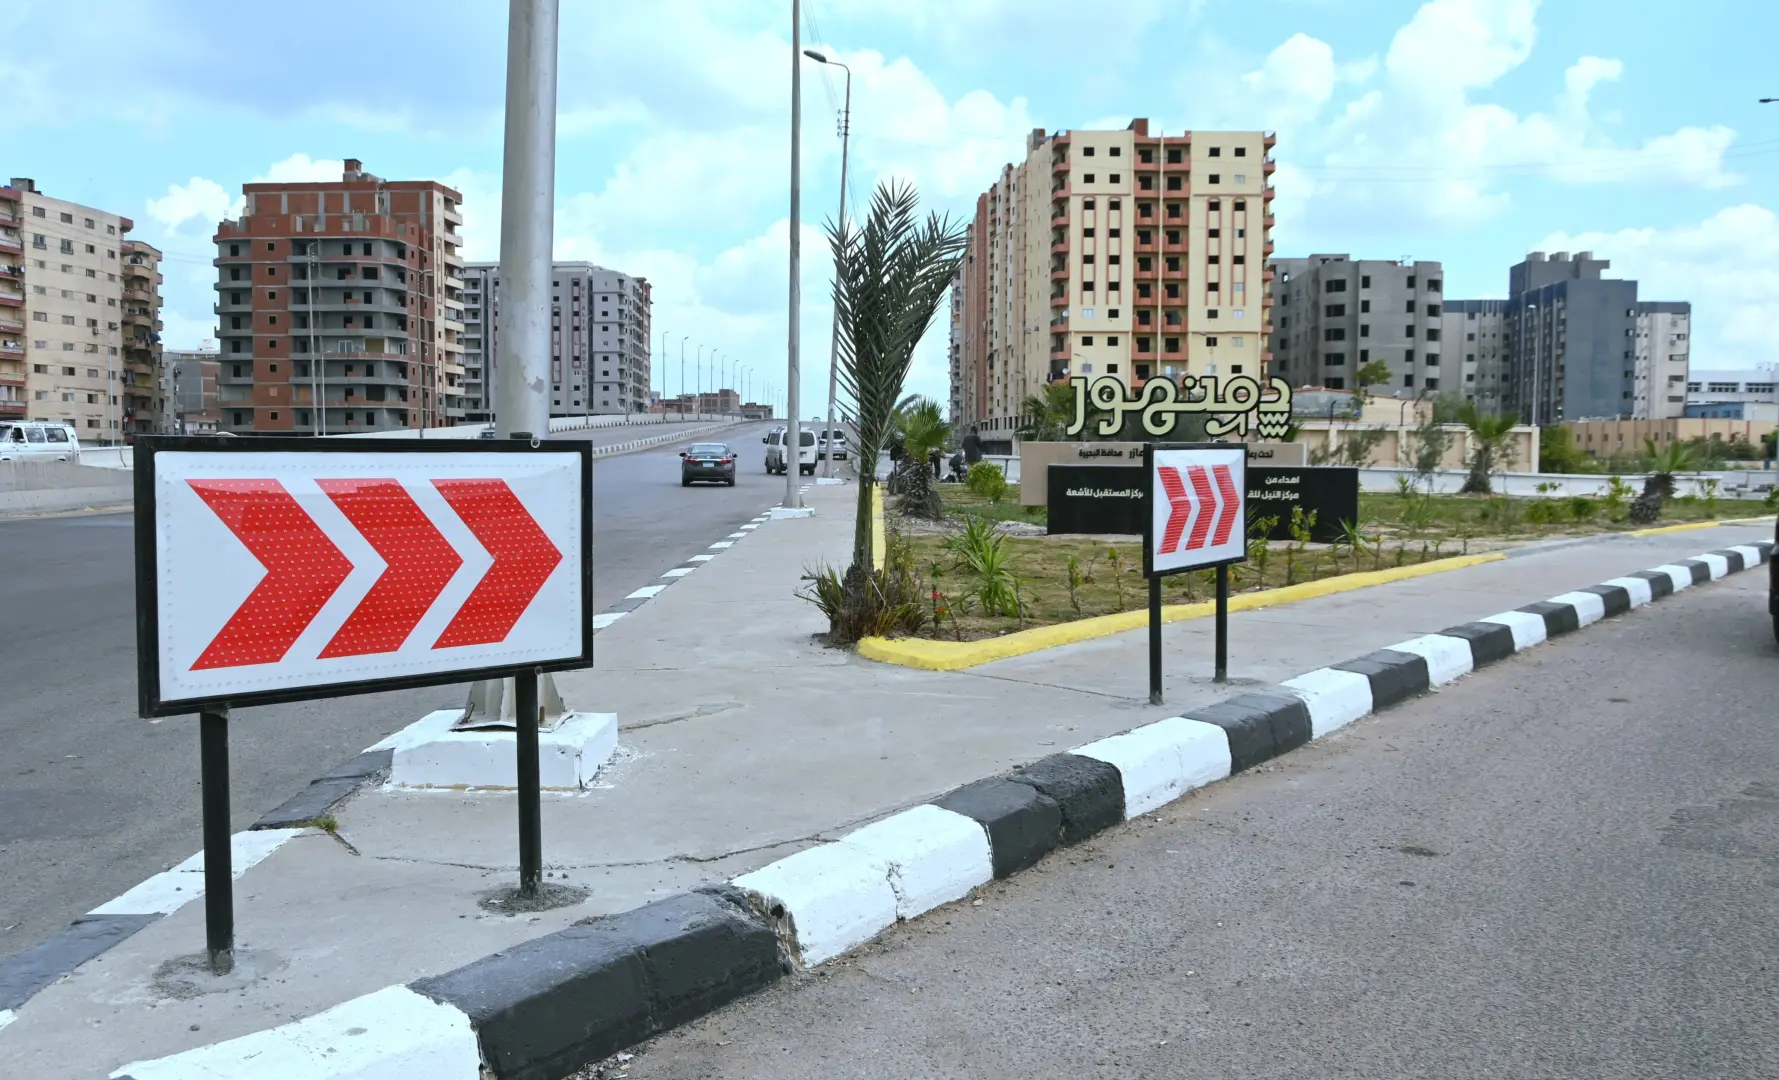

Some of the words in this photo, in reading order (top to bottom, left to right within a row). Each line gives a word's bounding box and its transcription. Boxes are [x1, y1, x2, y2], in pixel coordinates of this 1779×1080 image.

[1078, 448, 1100, 459] البحيرة
[1101, 448, 1123, 457] محافظ
[1258, 450, 1274, 458] تحت
[1265, 476, 1278, 485] من
[1066, 487, 1093, 497] للأشعة
[1093, 488, 1131, 498] المستقبل
[1261, 490, 1281, 500] النيل
[1281, 490, 1299, 500] مركز
